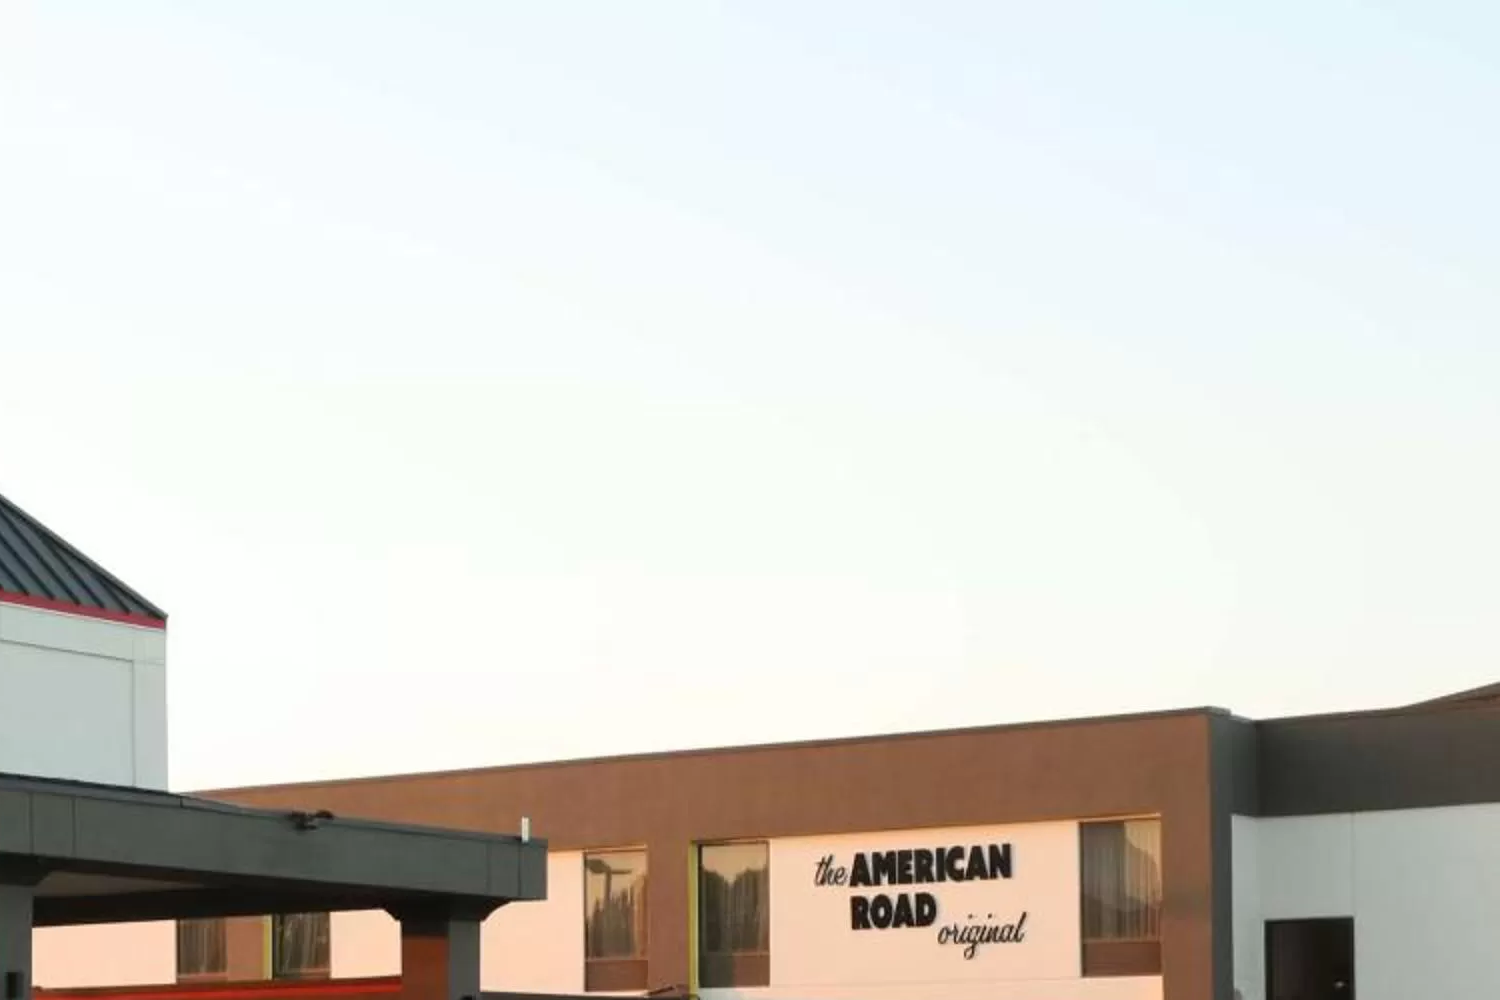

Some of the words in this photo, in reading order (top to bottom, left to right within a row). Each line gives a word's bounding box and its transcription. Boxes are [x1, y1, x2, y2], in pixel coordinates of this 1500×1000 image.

[814, 854, 847, 887] the
[849, 843, 1012, 887] AMERICAN
[850, 891, 937, 930] ROAD
[937, 911, 1027, 960] original
